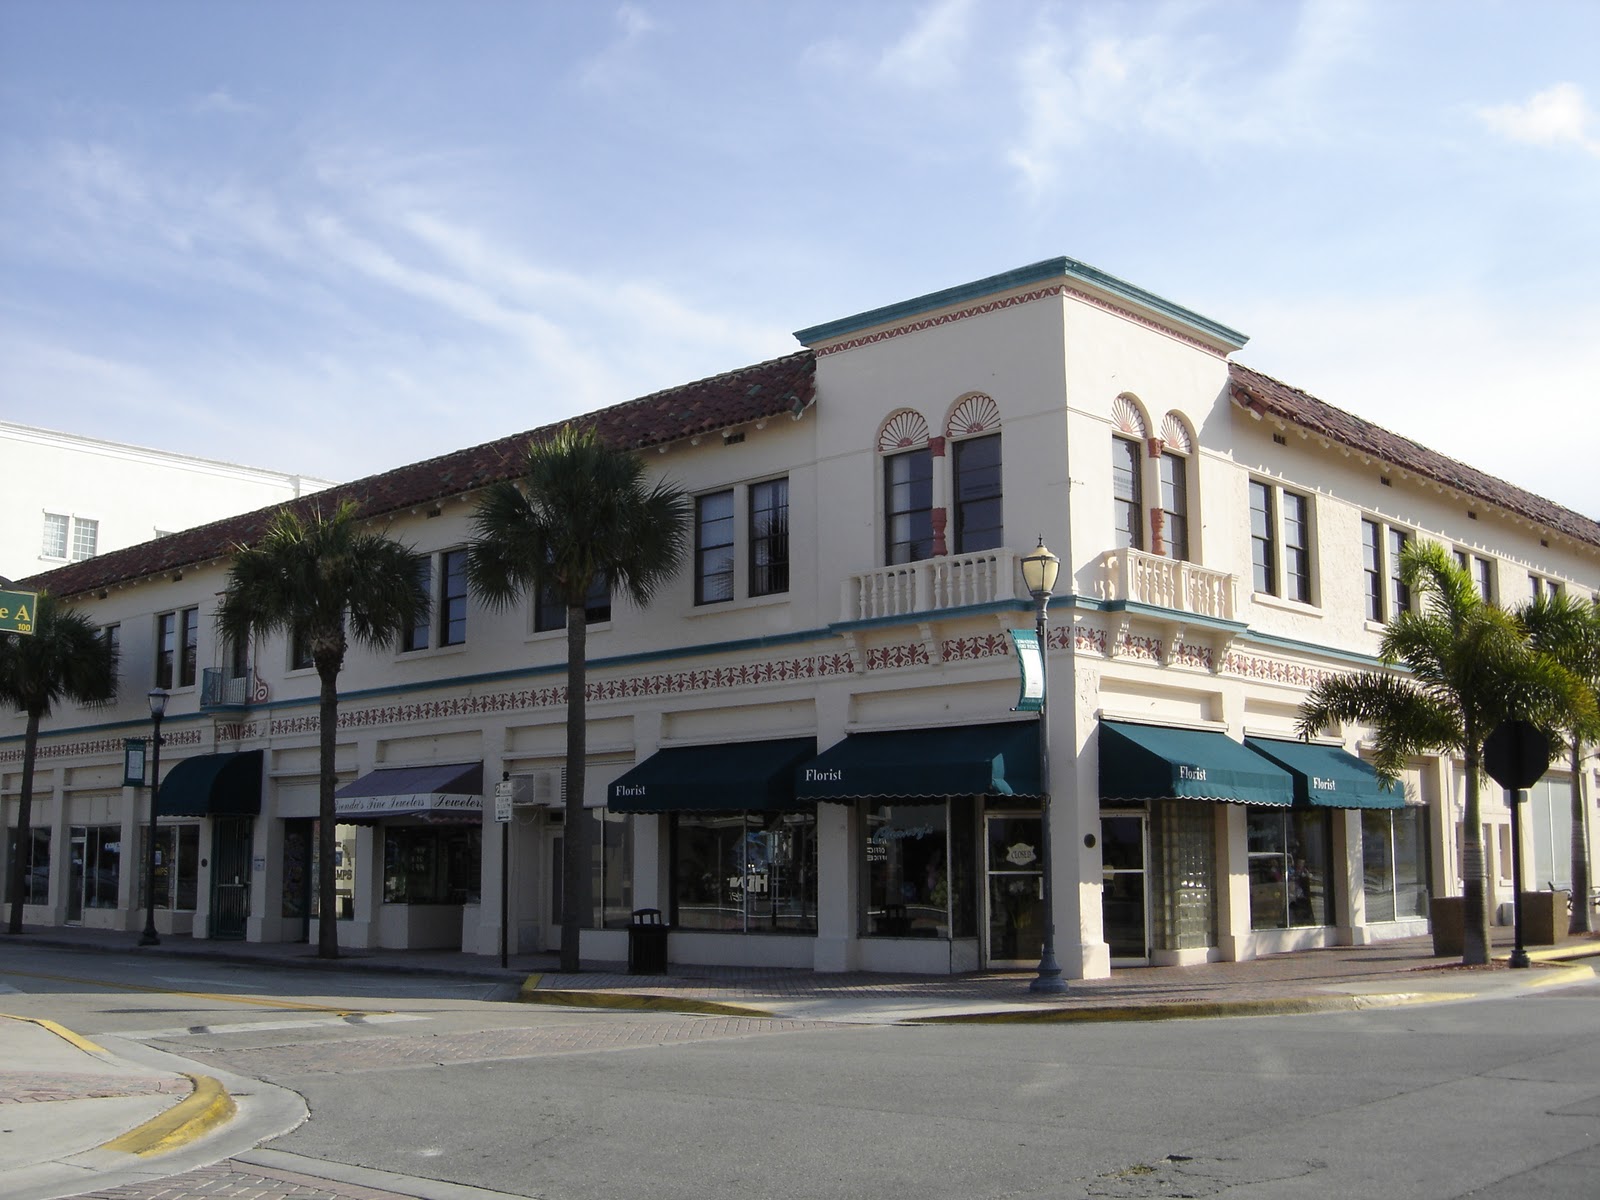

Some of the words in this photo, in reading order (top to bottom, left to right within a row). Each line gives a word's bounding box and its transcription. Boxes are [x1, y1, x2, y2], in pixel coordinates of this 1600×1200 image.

[14, 604, 31, 621] A
[18, 623, 31, 631] 100
[805, 768, 842, 782] Florist
[1179, 765, 1207, 781] Florist
[495, 785, 501, 796] 2
[615, 784, 646, 796] Florist
[1313, 776, 1336, 791] Florist
[367, 797, 385, 810] Fine
[389, 794, 425, 808] Jewelers
